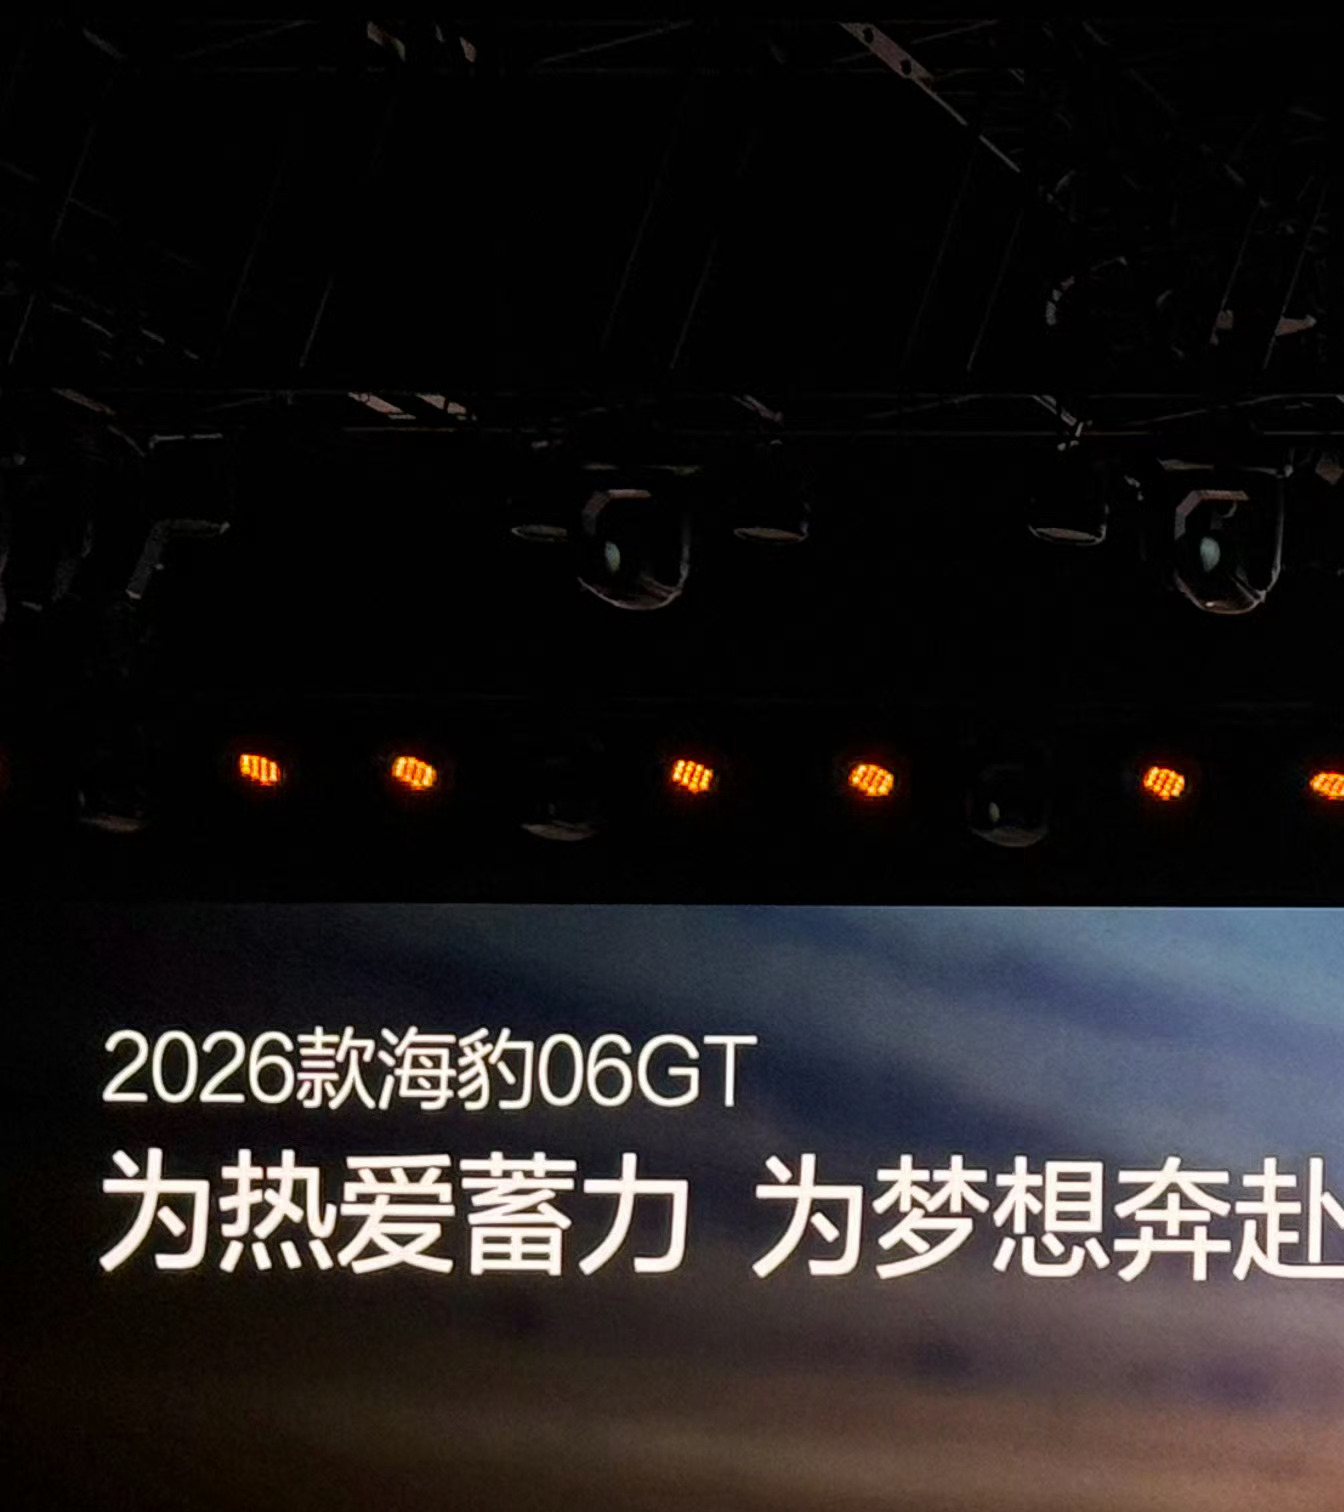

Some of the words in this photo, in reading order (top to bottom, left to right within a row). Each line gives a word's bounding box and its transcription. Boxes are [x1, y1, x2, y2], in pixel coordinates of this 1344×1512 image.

[101, 1026, 758, 1112] 2026款海豹06GT
[98, 1147, 691, 1277] 为热爱蓄力
